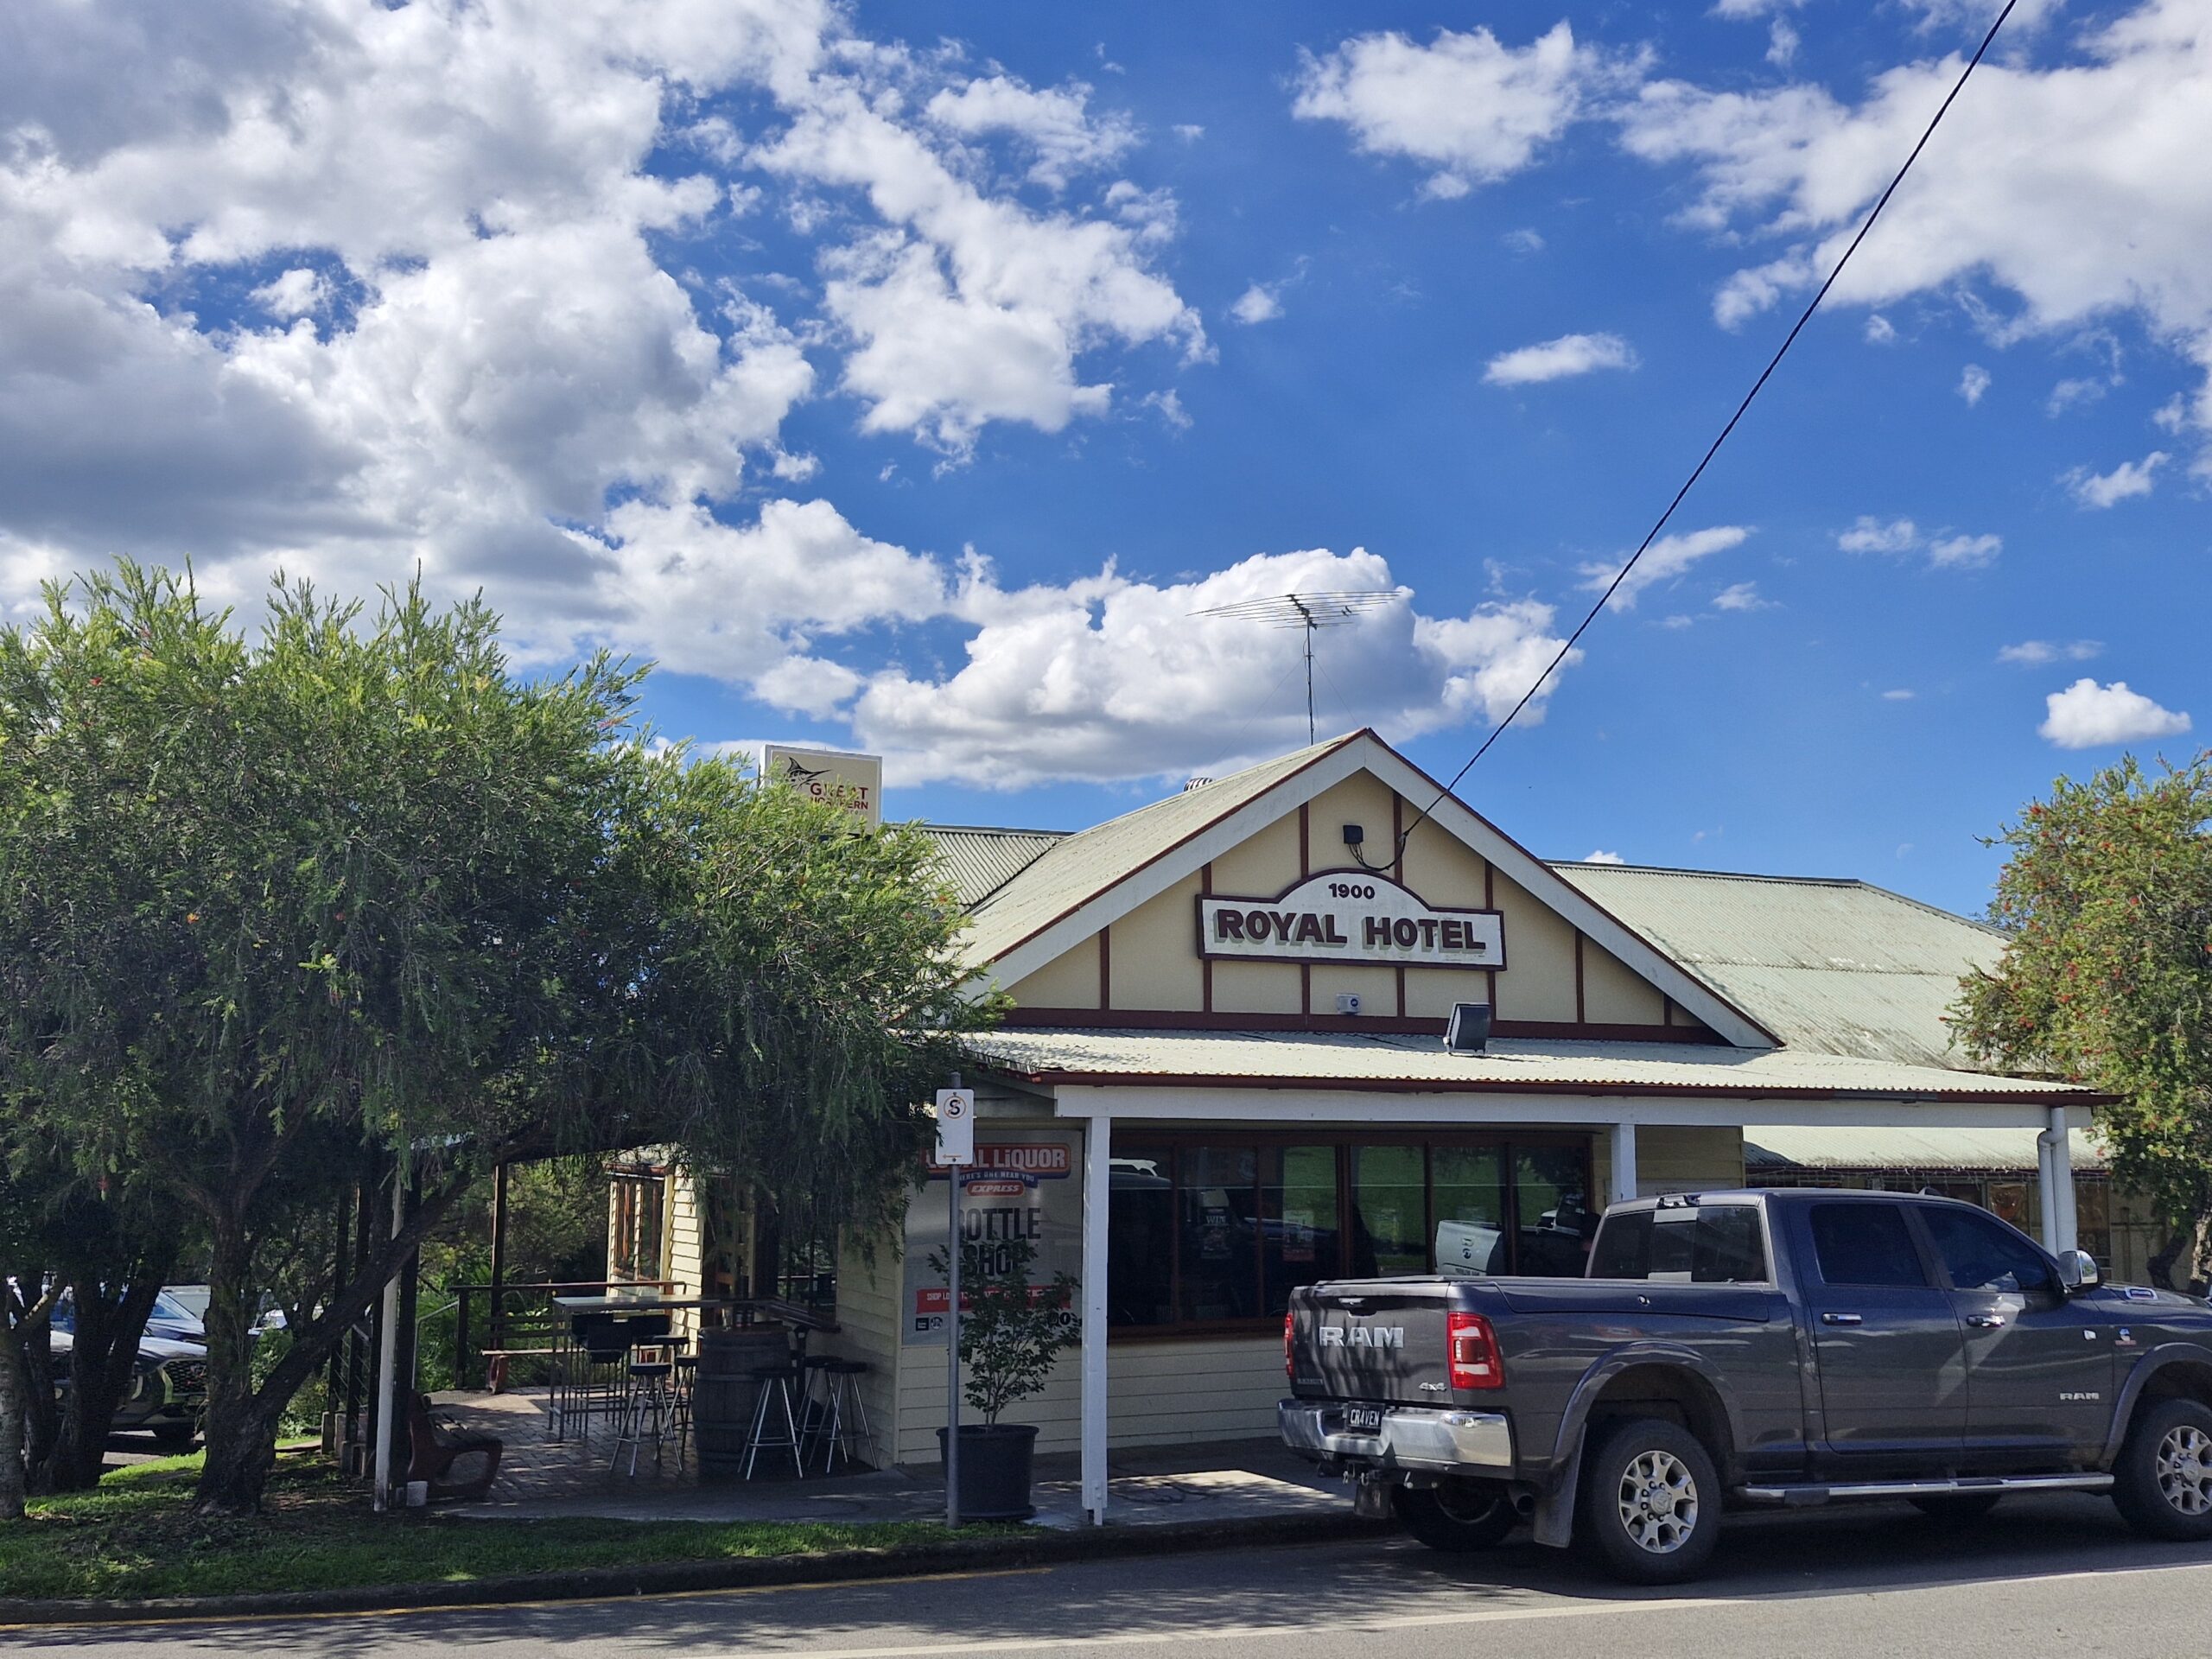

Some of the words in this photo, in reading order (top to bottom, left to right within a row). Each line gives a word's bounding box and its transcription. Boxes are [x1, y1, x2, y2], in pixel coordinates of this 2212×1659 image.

[1328, 883, 1376, 899] 1900
[1214, 909, 1348, 947] ROYAL
[1363, 916, 1486, 952] HOTEL
[1319, 1326, 1404, 1348] RAM
[2059, 1392, 2100, 1401] RAM
